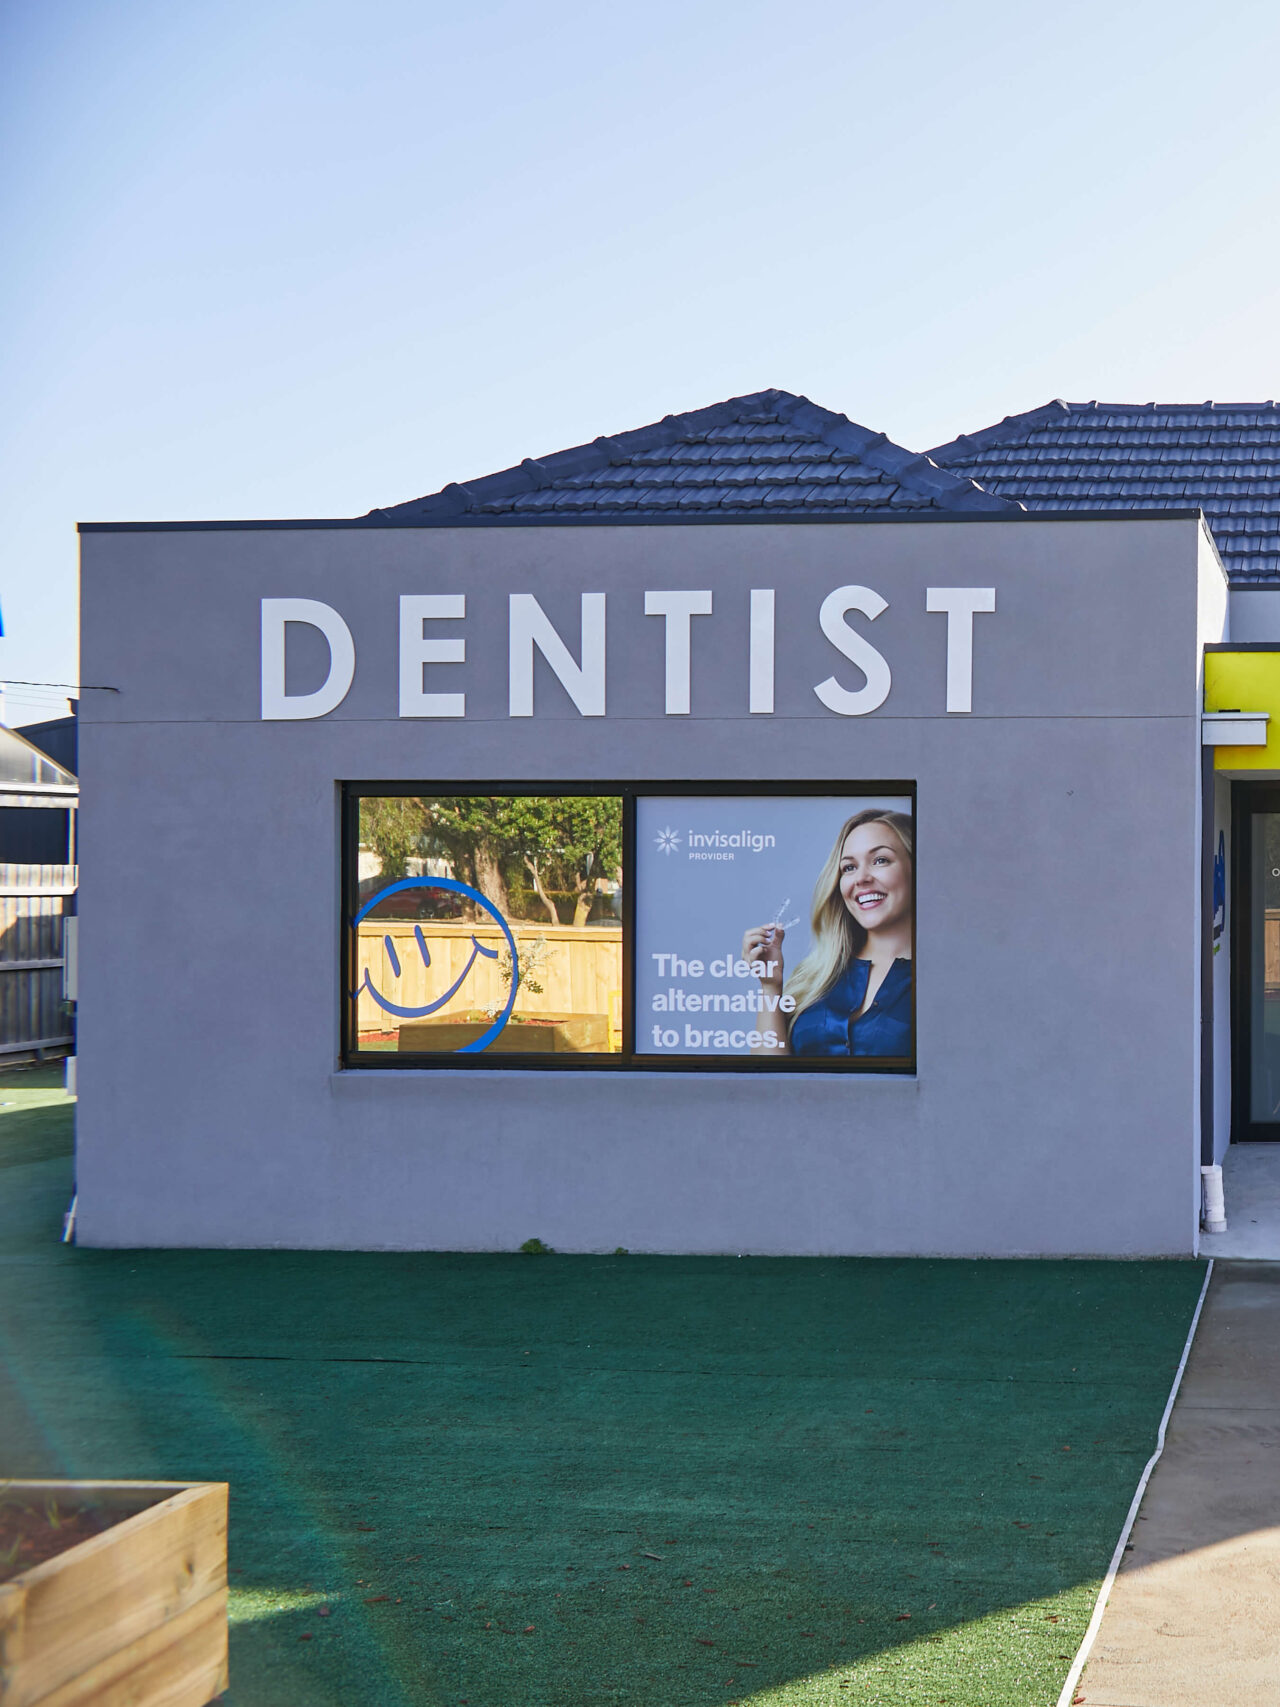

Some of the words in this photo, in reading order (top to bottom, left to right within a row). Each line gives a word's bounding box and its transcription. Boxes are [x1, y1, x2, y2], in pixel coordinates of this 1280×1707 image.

[261, 585, 997, 721] DENTIST
[688, 830, 776, 852] invisalign
[688, 852, 735, 861] PROVIDER
[652, 953, 705, 977] The
[709, 954, 779, 978] clear
[652, 988, 797, 1013] alternative
[652, 1025, 680, 1048] to
[685, 1023, 785, 1048] braces.
